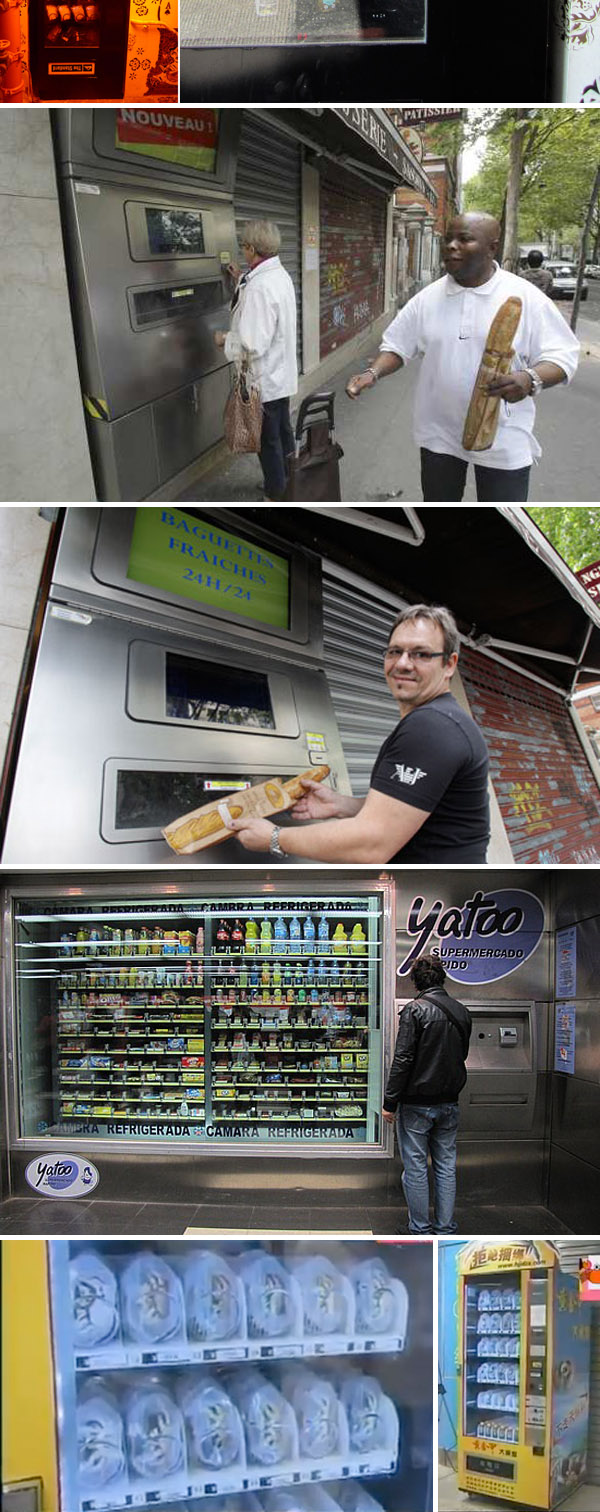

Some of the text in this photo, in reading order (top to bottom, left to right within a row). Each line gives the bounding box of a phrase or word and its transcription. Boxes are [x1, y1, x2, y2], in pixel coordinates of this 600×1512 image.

[121, 108, 204, 132] NOUVEAU
[161, 511, 274, 569] BAGUETTES
[168, 537, 267, 585] FRAICHES
[182, 568, 252, 601] 24H/24
[263, 900, 352, 912] REFRIGERADA
[431, 947, 524, 959] SUPERMERCADO
[107, 1123, 191, 1136] REFRIGERADA
[267, 1126, 355, 1138] REFRIGERADA
